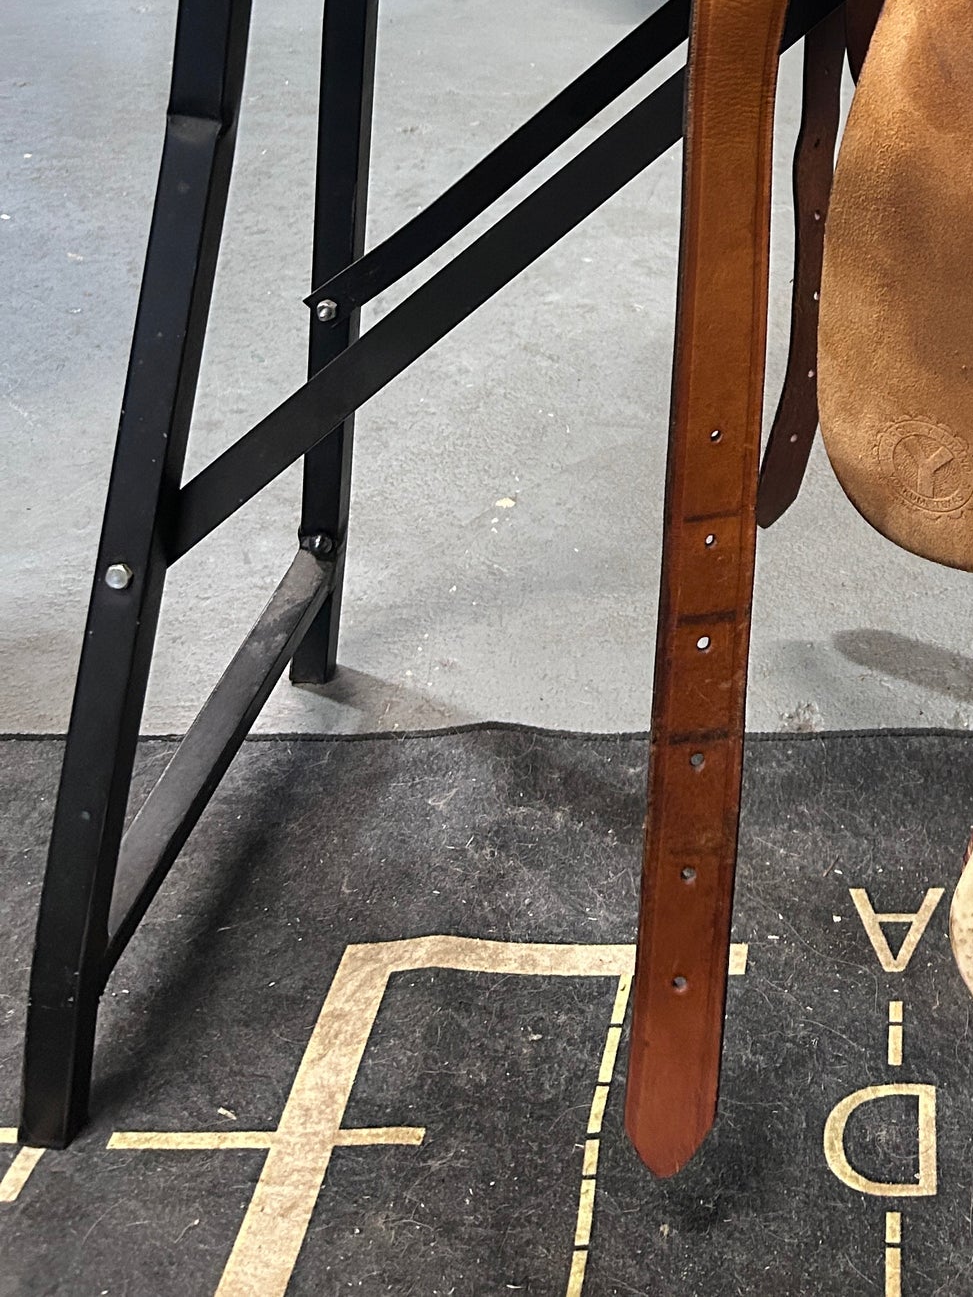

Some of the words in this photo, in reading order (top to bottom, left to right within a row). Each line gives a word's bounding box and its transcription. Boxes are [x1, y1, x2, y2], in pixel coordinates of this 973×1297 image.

[902, 436, 955, 499] Y
[849, 888, 945, 972] A
[824, 1083, 937, 1197] D
